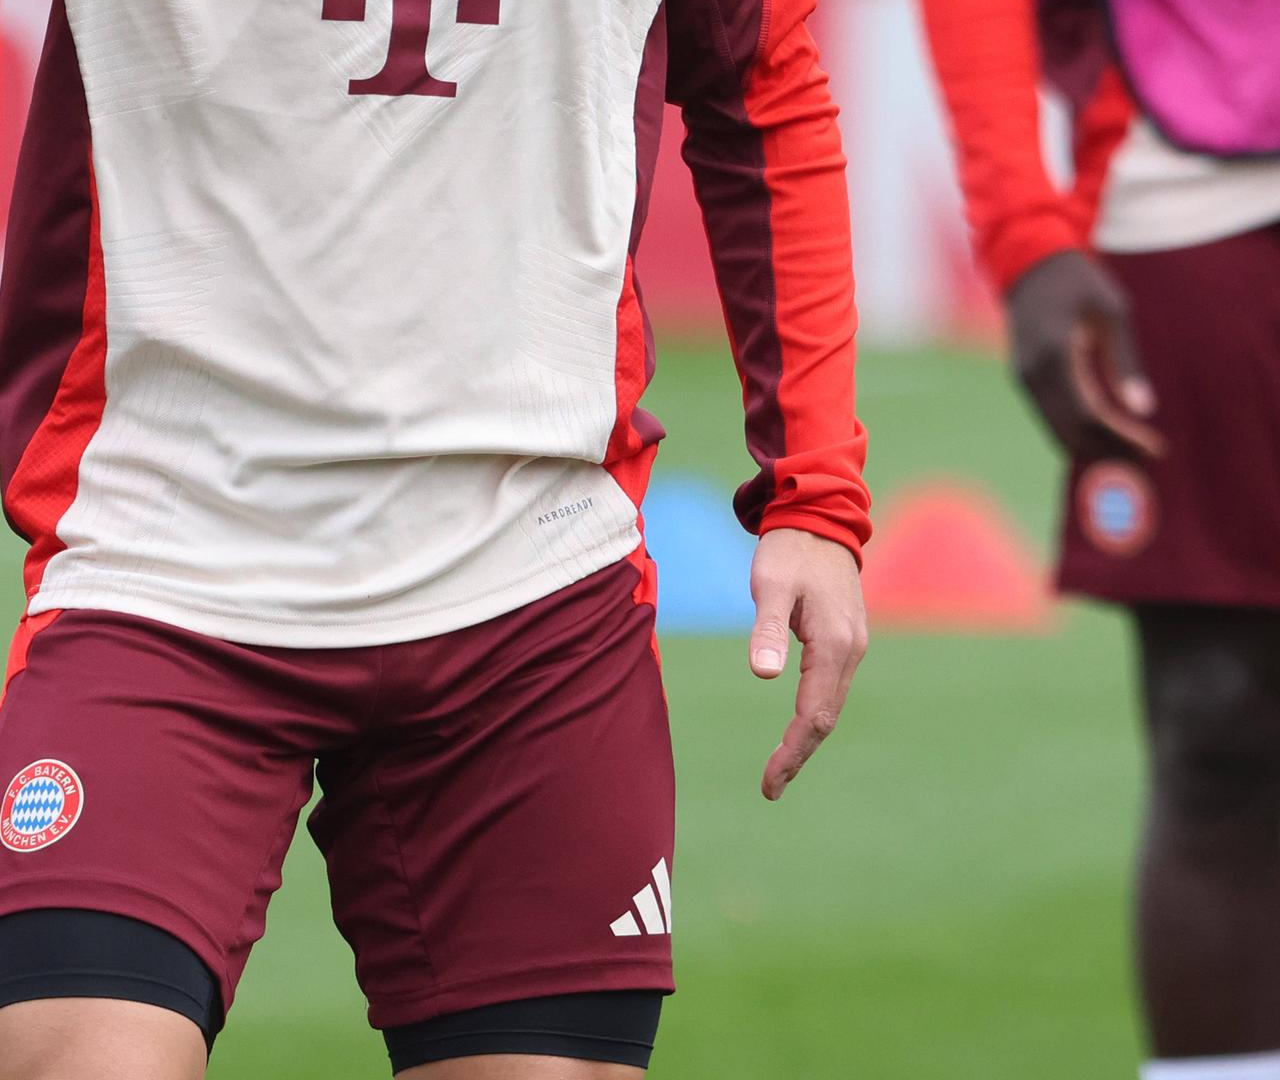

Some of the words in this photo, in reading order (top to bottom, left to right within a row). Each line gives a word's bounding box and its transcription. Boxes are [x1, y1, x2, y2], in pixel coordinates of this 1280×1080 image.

[34, 765, 77, 796] BAYERN
[2, 816, 47, 847] MÜNCHEN
[50, 813, 72, 835] E.V.
